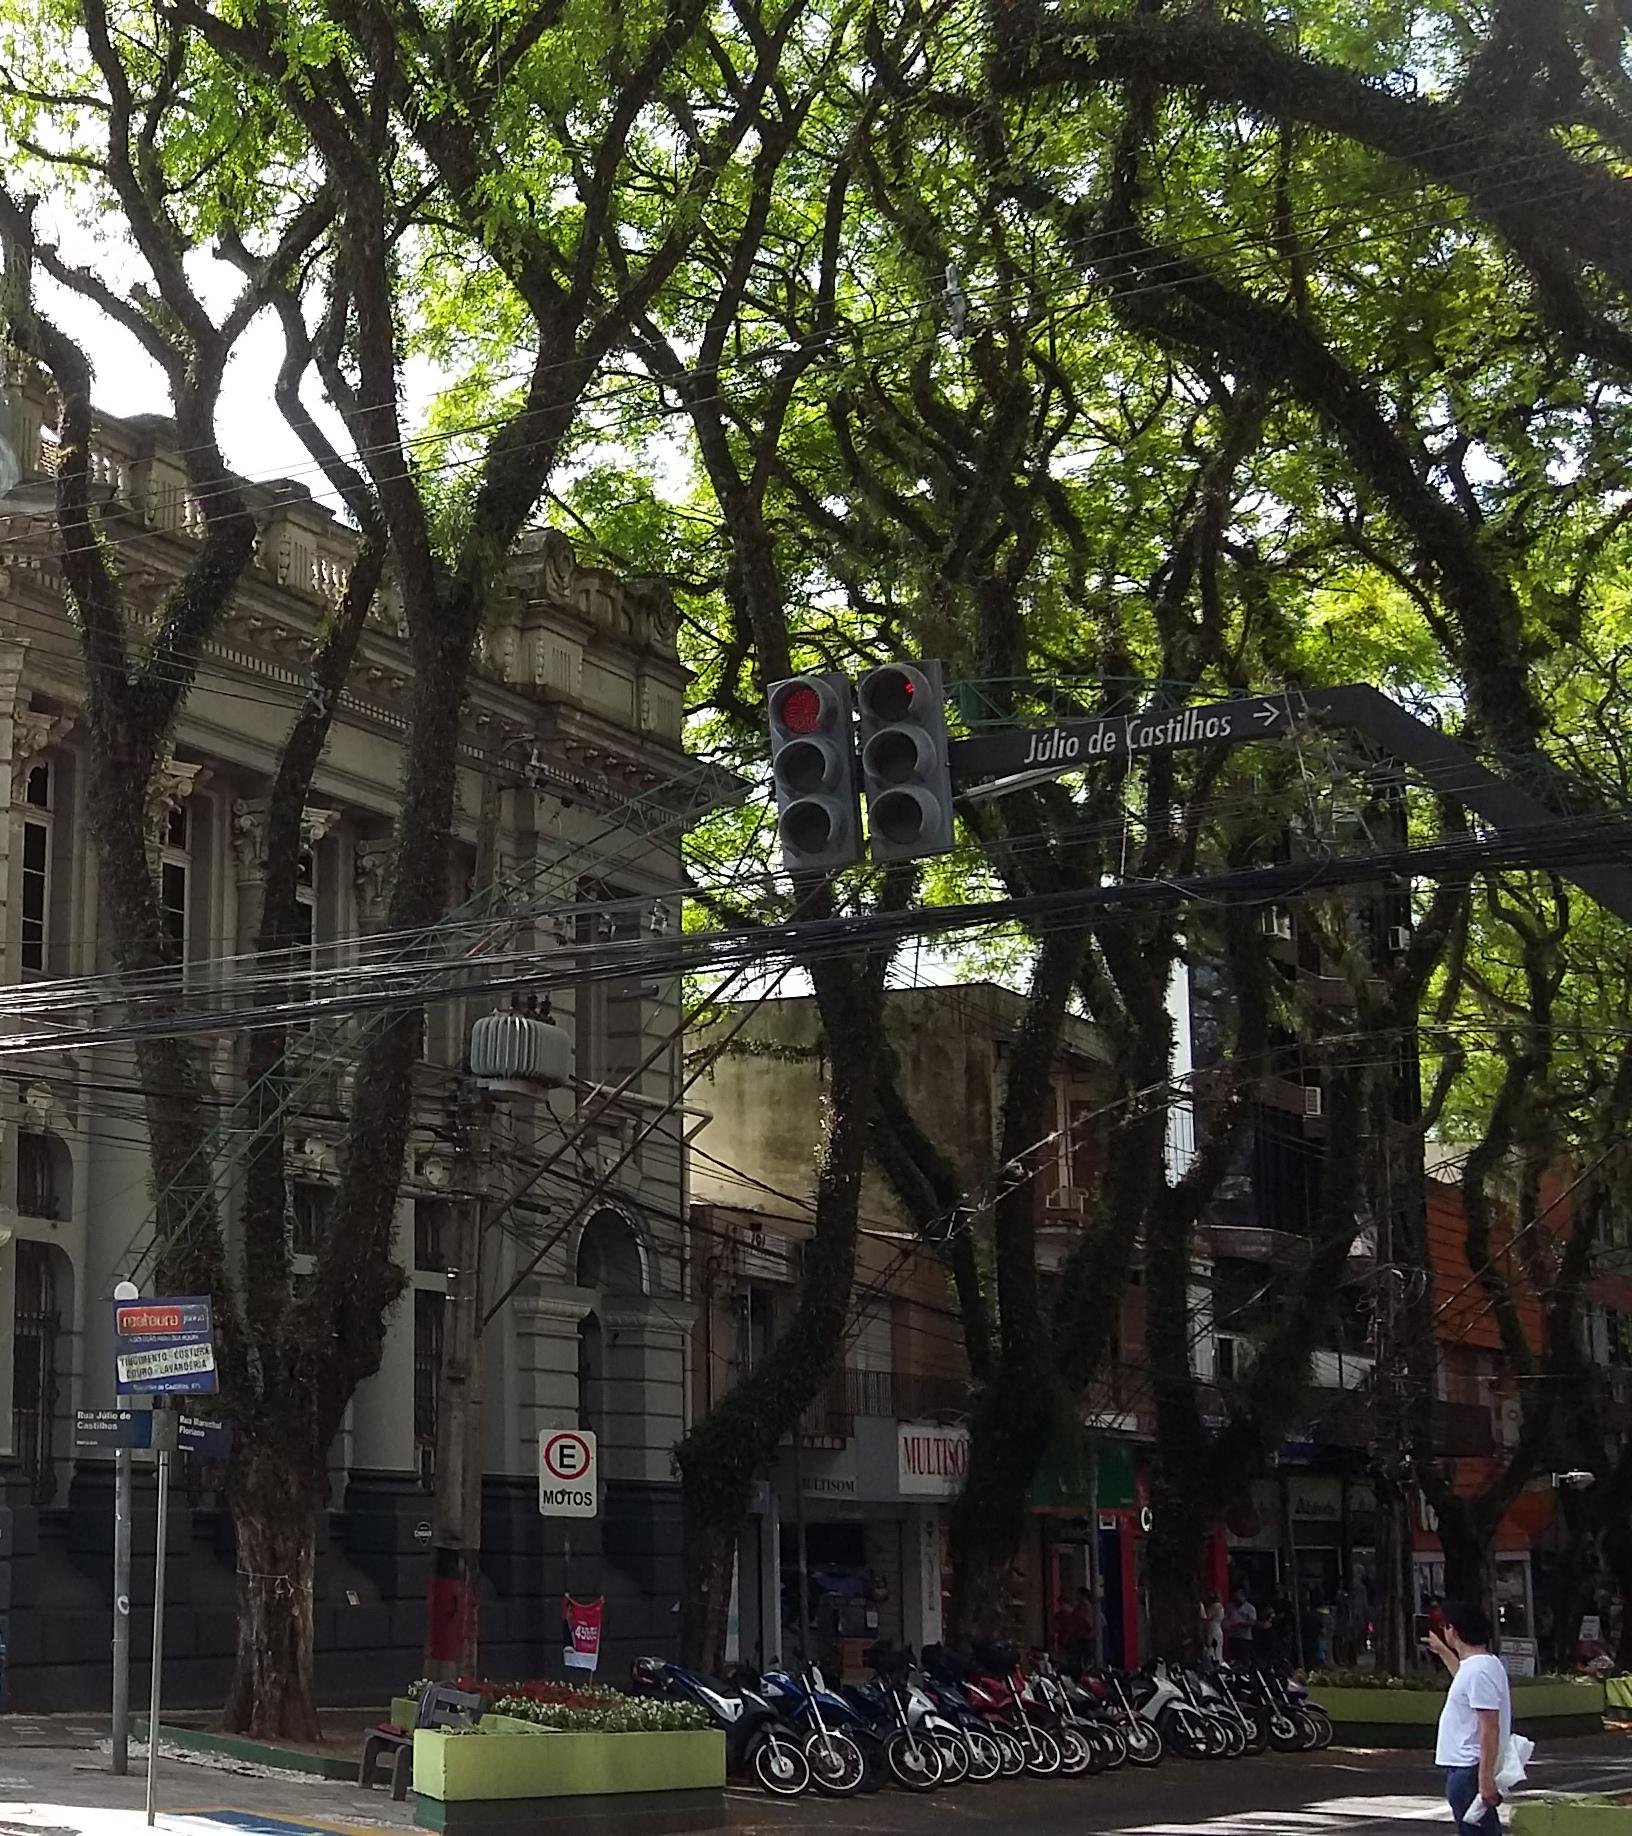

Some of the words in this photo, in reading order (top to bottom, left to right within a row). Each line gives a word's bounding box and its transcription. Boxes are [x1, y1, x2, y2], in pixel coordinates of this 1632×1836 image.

[1024, 727, 1079, 764] Júlio
[1088, 722, 1116, 754] de
[1127, 709, 1231, 749] Castilhos
[174, 1346, 209, 1359] COSTURA
[160, 1359, 207, 1374] LAVANDERIA
[77, 1411, 94, 1419] Rua
[96, 1410, 118, 1420] Júlio
[119, 1411, 131, 1420] de
[77, 1421, 118, 1430] Castilhos
[559, 1444, 577, 1469] E
[543, 1489, 593, 1507] MOTOS
